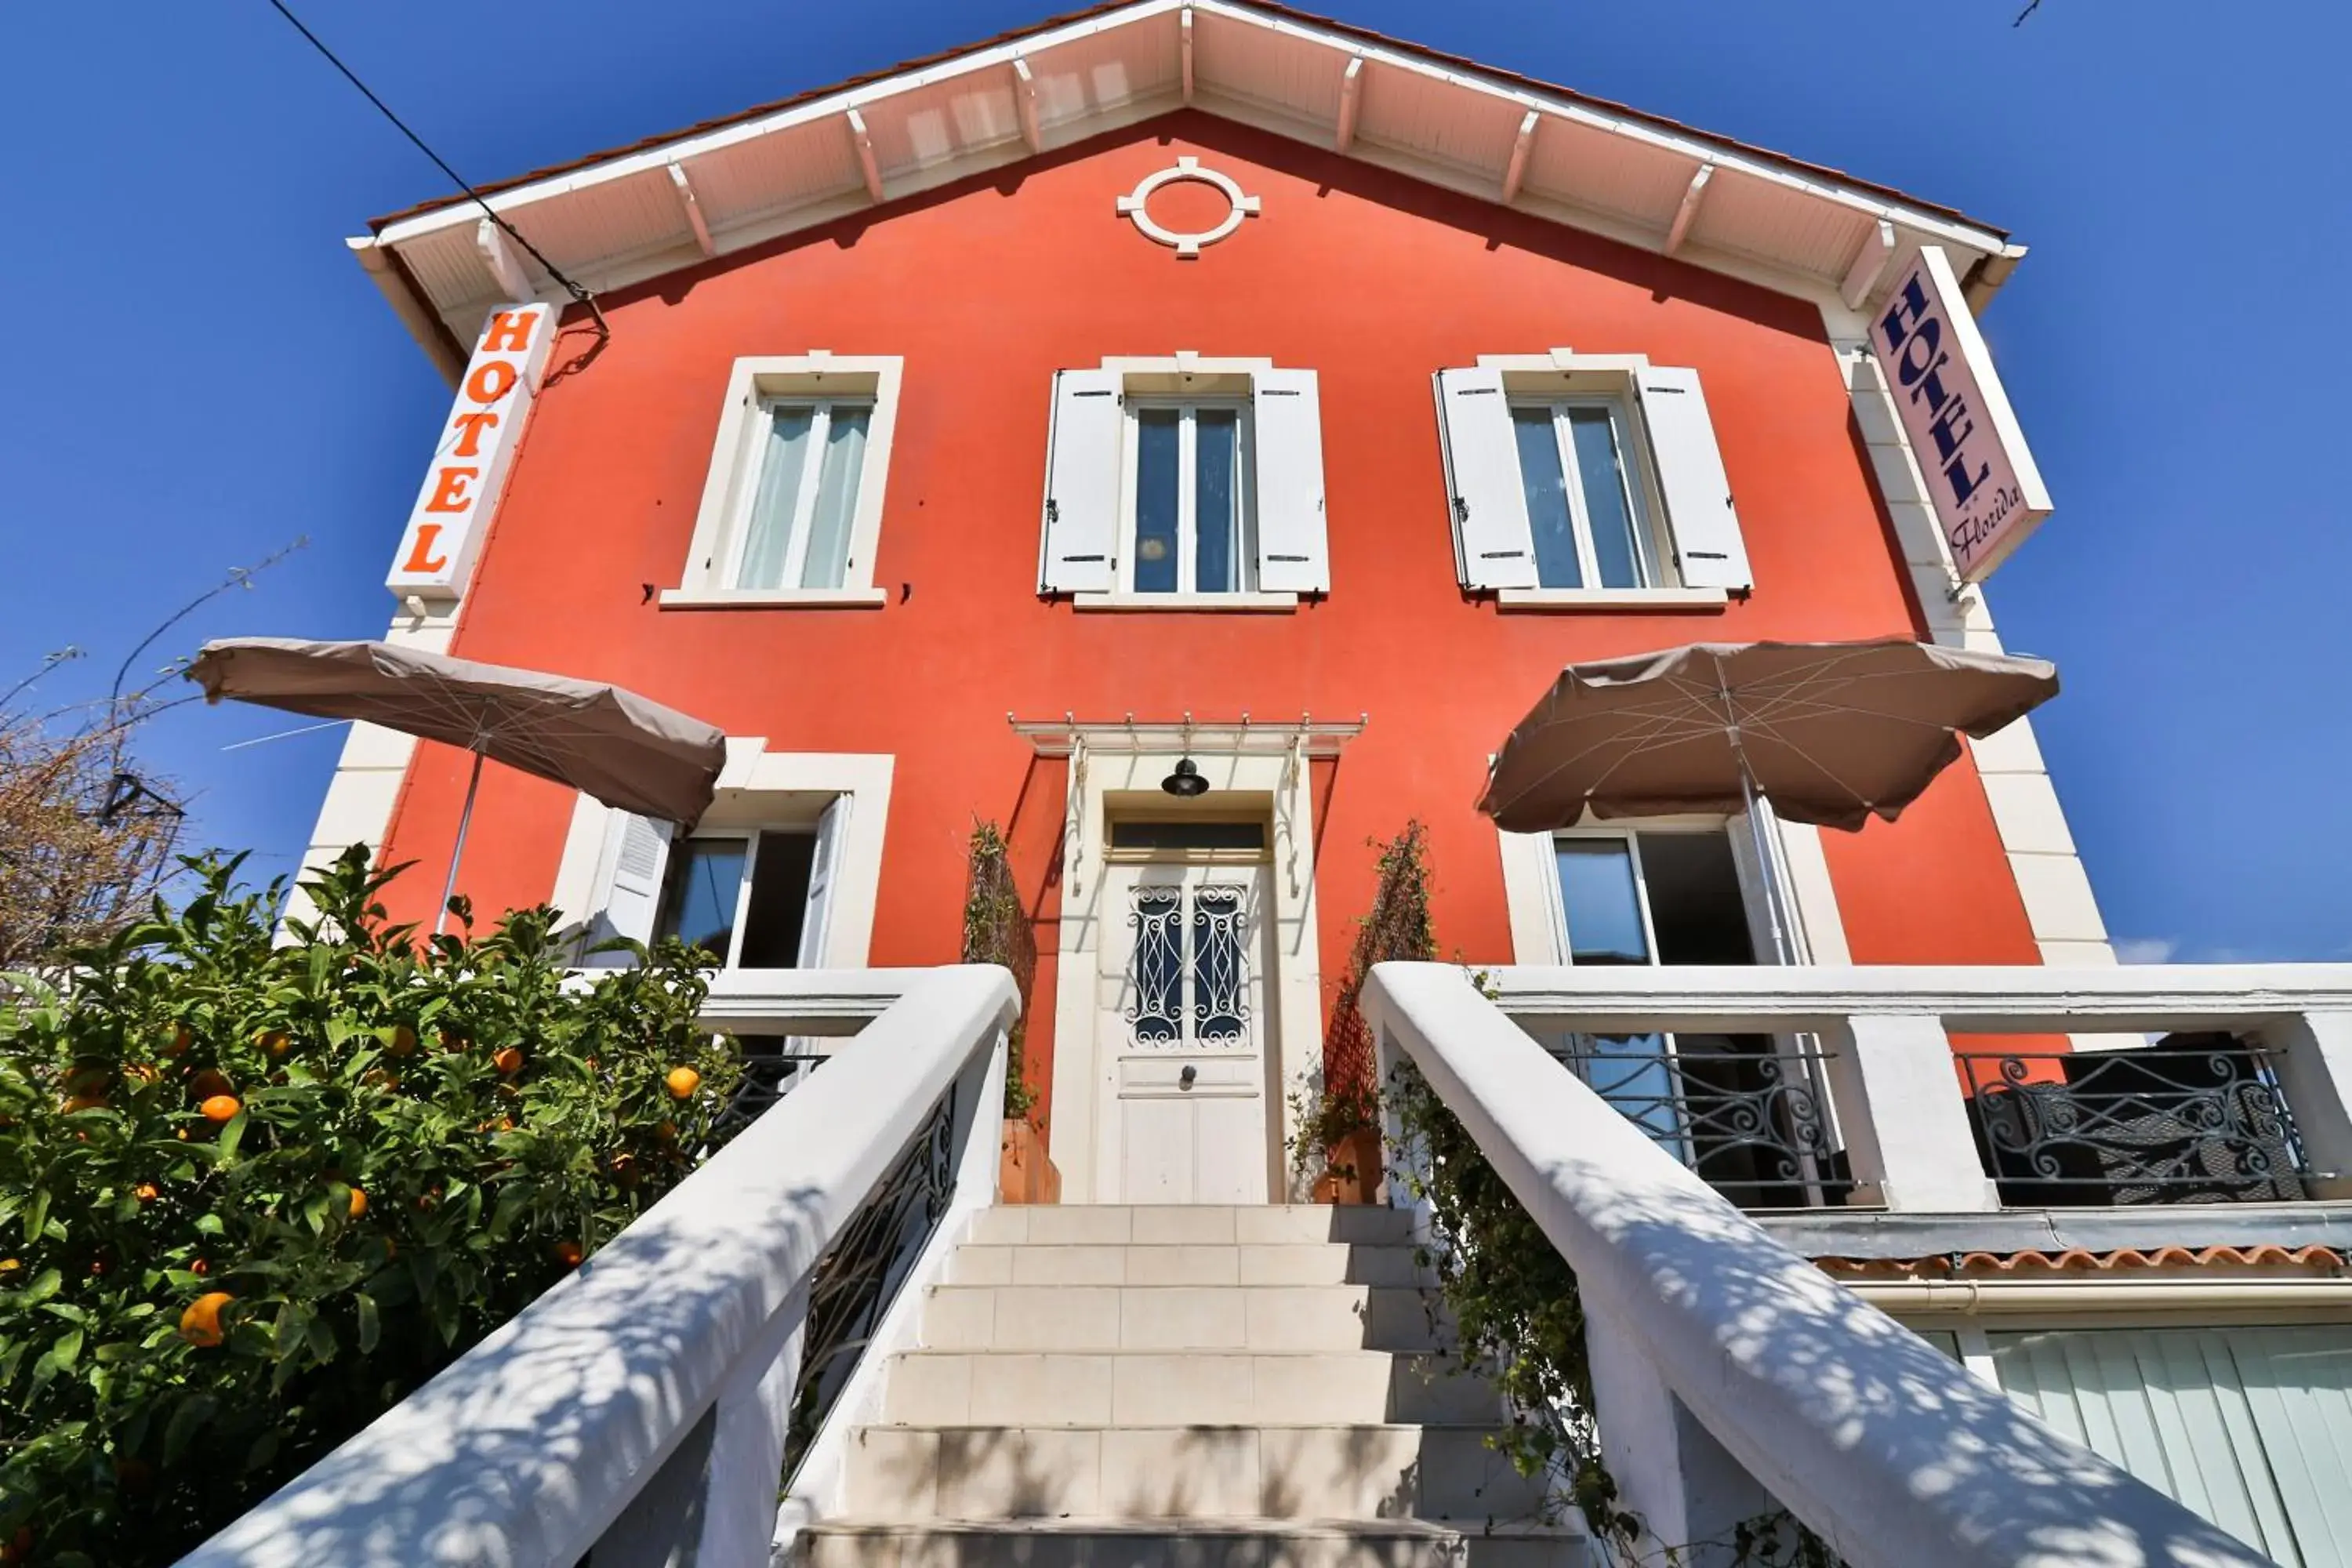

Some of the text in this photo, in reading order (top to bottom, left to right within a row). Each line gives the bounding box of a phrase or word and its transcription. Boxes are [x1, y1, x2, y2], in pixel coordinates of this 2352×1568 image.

[403, 312, 539, 572] HOTEL
[1881, 271, 1990, 510] HOTEL
[1951, 485, 2020, 561] Florida
